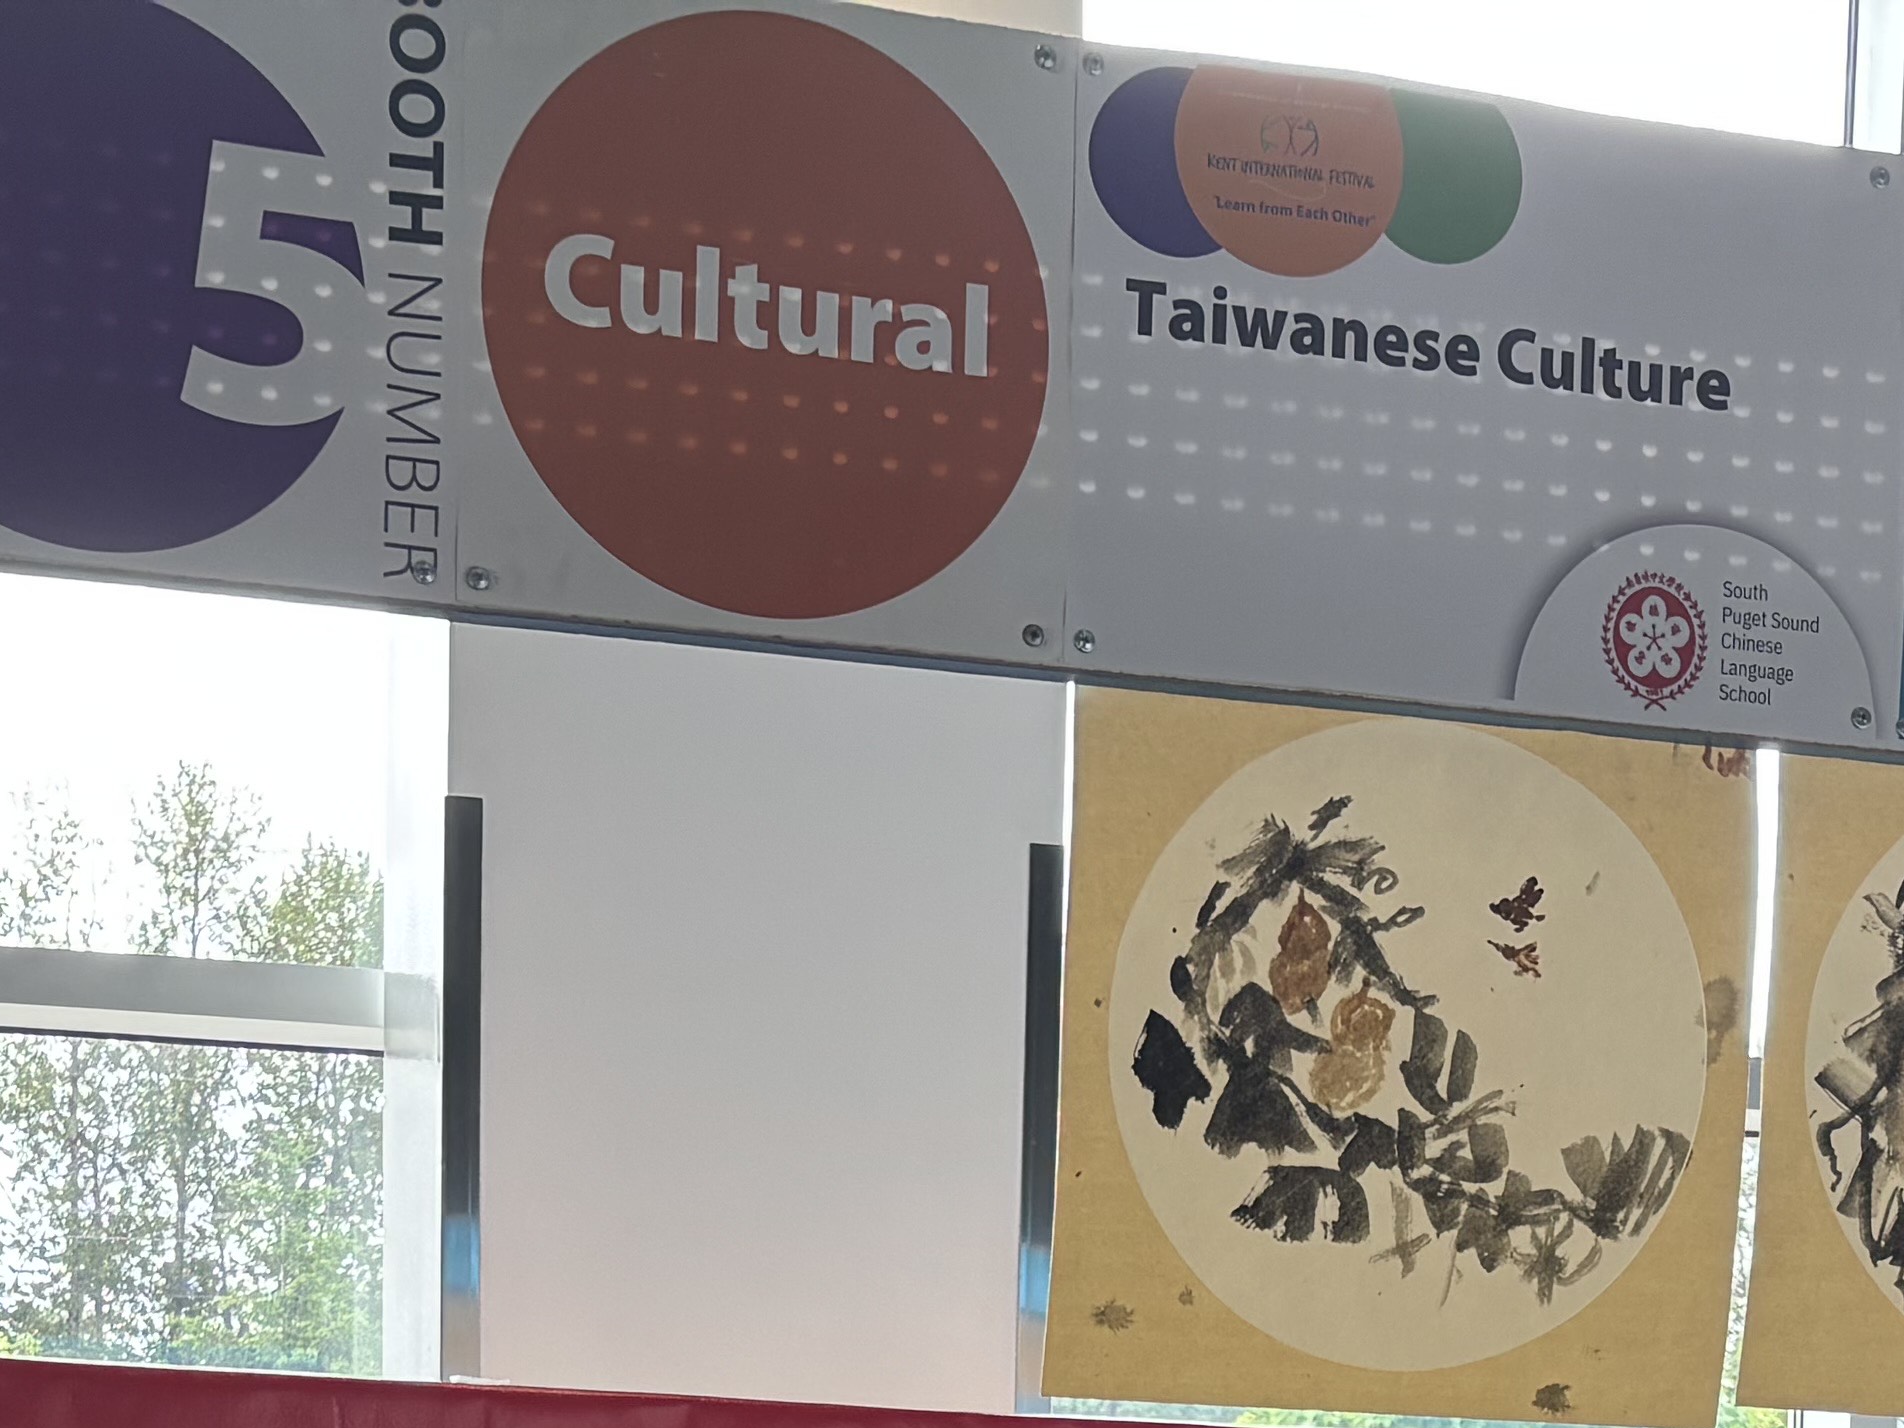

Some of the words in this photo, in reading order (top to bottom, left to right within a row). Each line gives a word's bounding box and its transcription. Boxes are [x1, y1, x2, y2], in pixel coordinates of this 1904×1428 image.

[387, 0, 446, 246] OOTH
[1207, 152, 1237, 172] KENT
[1241, 159, 1324, 182] INTERNATIONAL
[1329, 169, 1376, 189] FESTIVAL
[1259, 200, 1293, 217] from
[1296, 205, 1329, 222] Each
[180, 139, 367, 426] 5
[539, 229, 992, 381] Cultural
[1125, 277, 1480, 381] Taiwanese
[1495, 328, 1733, 413] Culture
[382, 272, 444, 578] NUMBER
[1722, 580, 1769, 602] South
[1722, 607, 1767, 631] Puget
[1771, 612, 1820, 633] Sound
[1721, 632, 1783, 655] Chinese
[1720, 658, 1794, 685] Language
[1718, 684, 1771, 706] School
